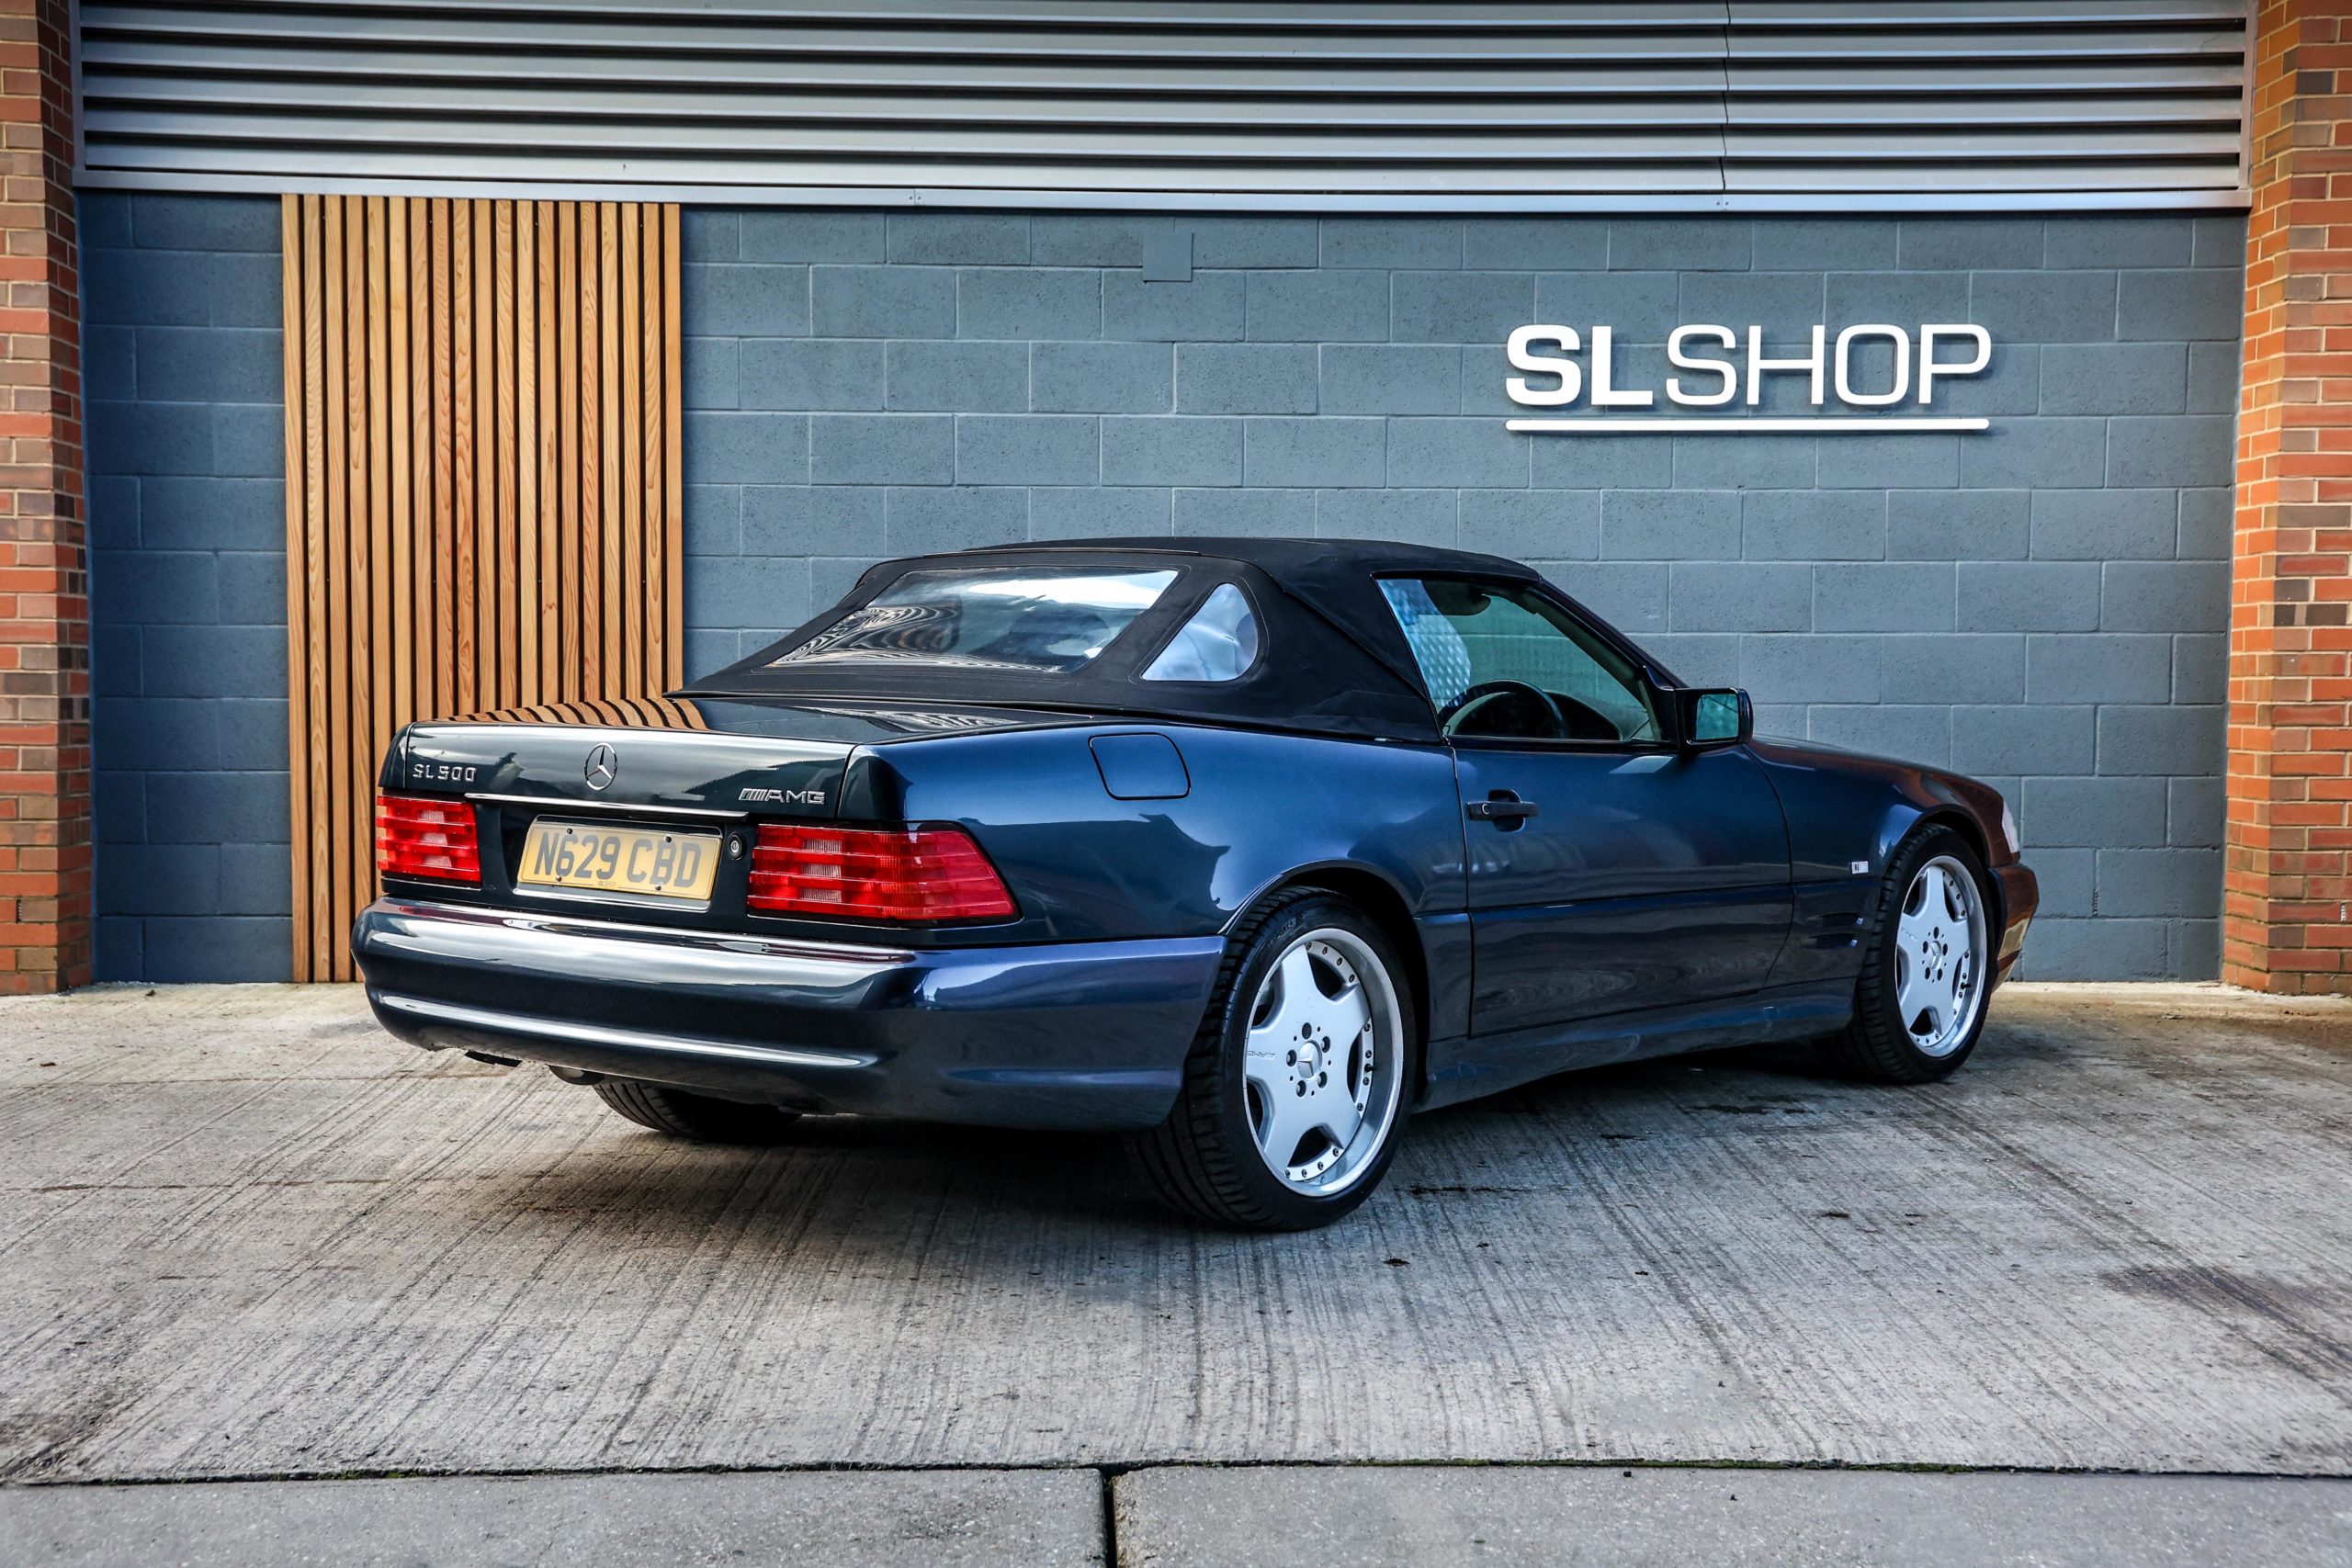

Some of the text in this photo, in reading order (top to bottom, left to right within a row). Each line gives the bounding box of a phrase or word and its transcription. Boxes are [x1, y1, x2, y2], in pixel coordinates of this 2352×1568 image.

[763, 789, 826, 806] AMG
[533, 830, 702, 888] N629 CBD
